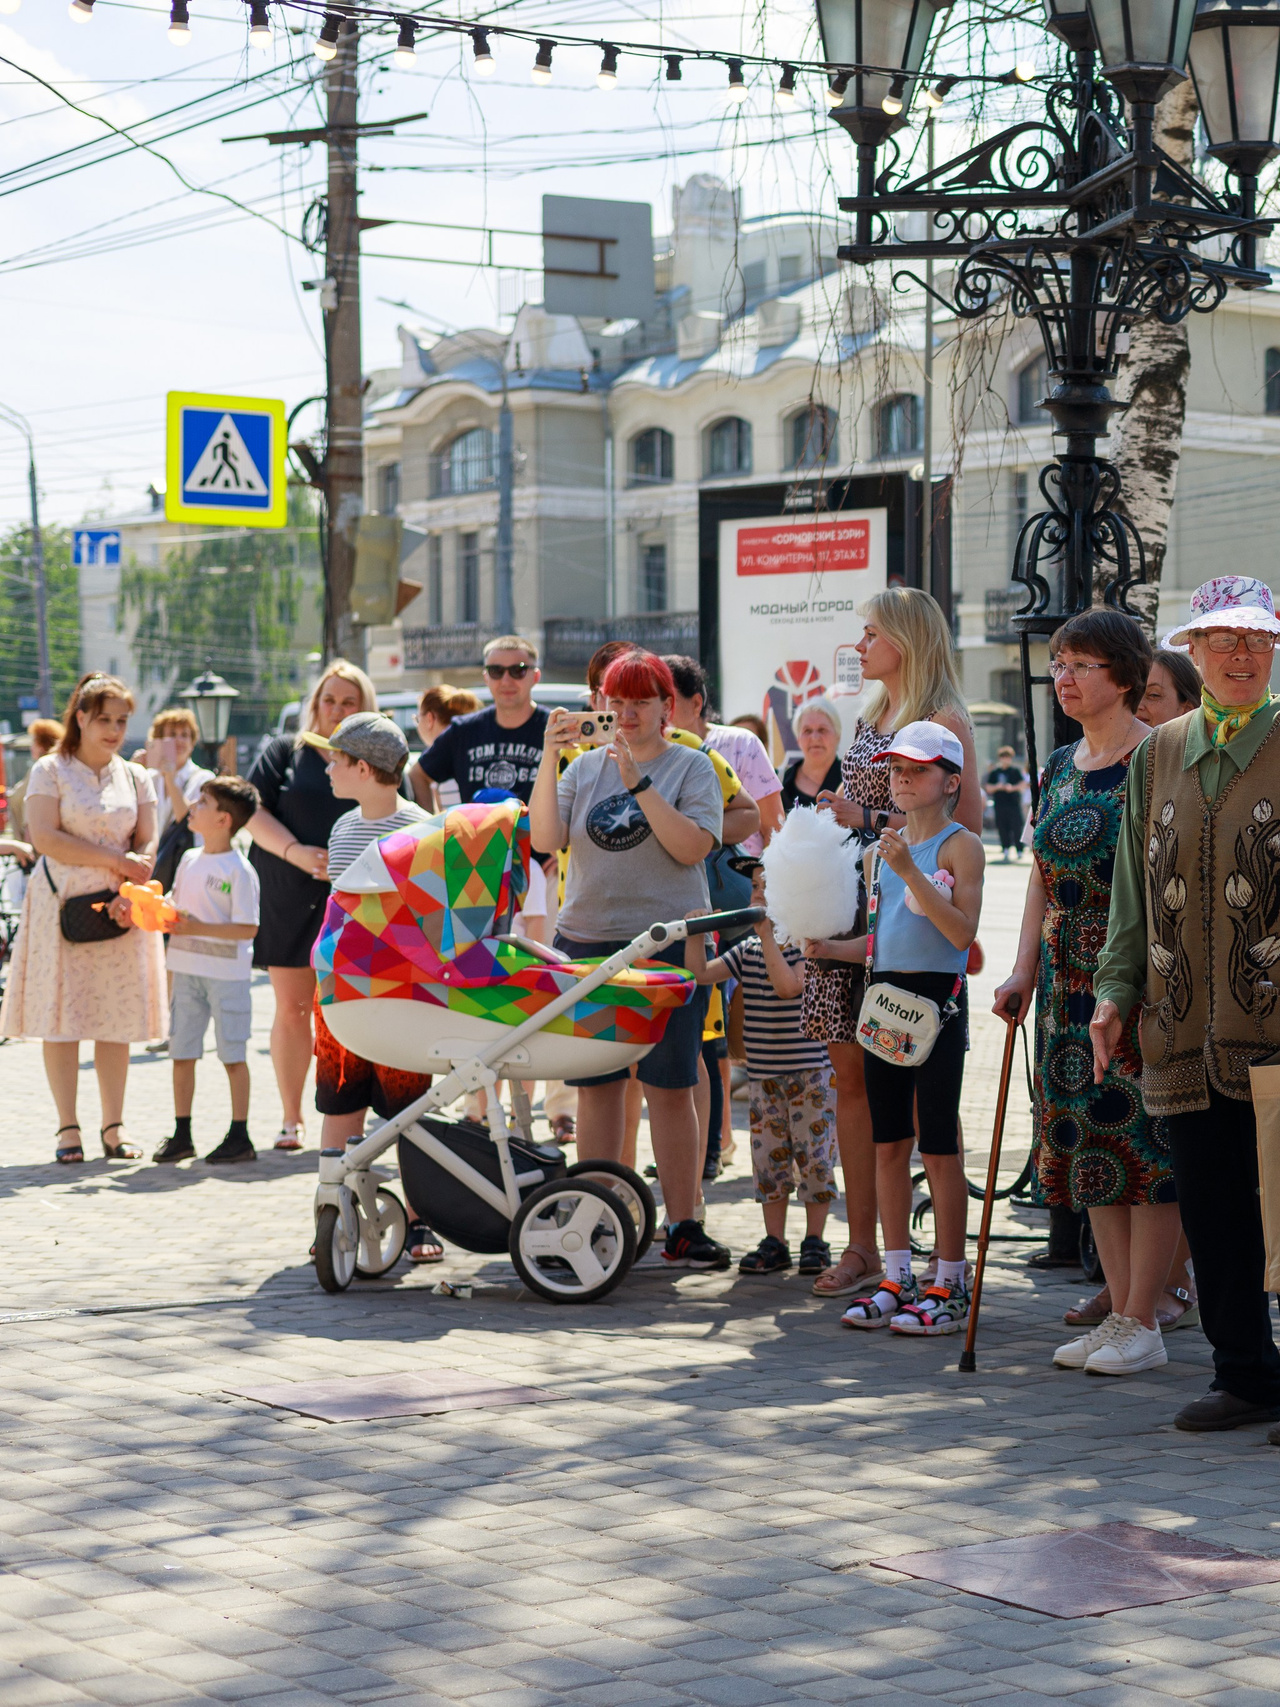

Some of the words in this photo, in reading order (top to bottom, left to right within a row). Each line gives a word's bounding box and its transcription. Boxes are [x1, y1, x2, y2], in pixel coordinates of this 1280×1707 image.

[833, 549, 858, 561] ЭТАЖ
[859, 548, 866, 560] 3
[750, 601, 809, 615] МОДНЫЙ
[811, 600, 854, 613] ГОРОД
[468, 743, 496, 761] TOM
[468, 766, 485, 782] 19
[518, 767, 538, 782] 62
[593, 825, 609, 842] NEW
[610, 825, 645, 845] FASHION
